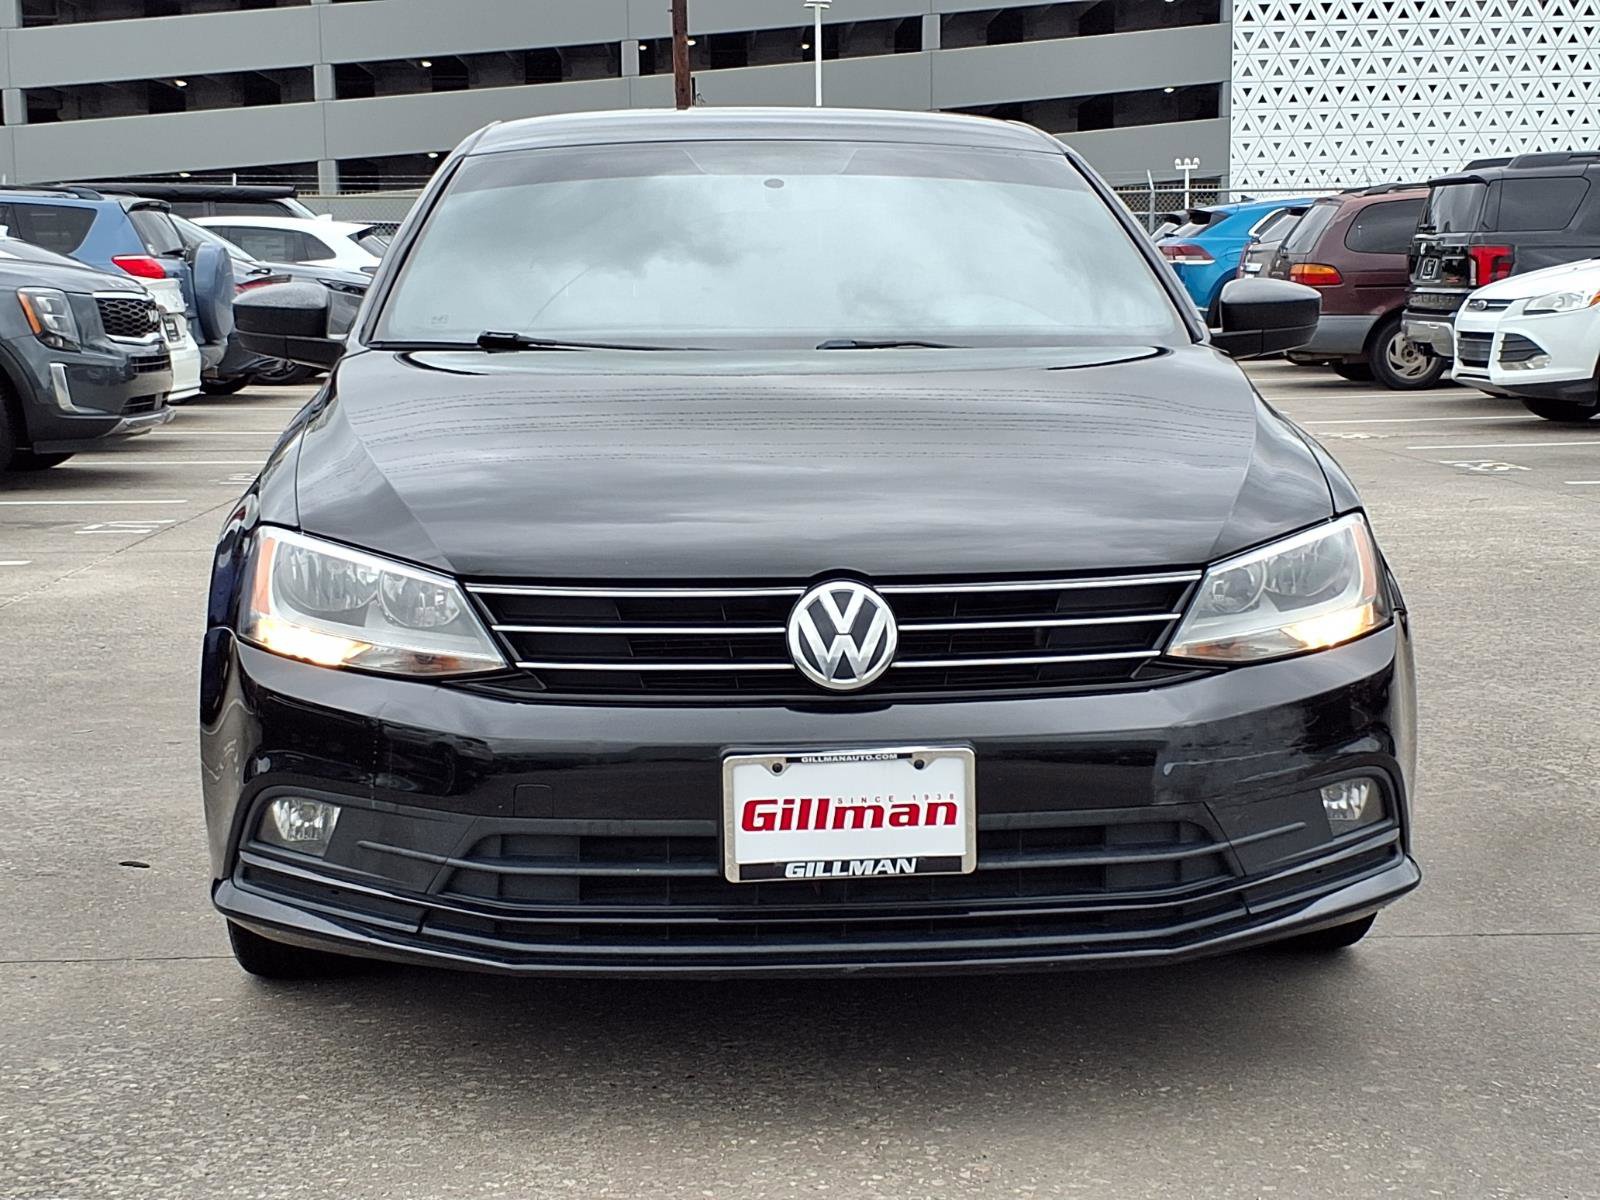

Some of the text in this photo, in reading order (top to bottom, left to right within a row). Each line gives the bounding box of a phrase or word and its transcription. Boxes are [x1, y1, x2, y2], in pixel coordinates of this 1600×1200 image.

[800, 753, 898, 763] GILLMANAUTO.COM
[837, 793, 954, 804] SINCE 1938
[741, 797, 958, 832] Gillman
[784, 857, 917, 878] GILLMAN
